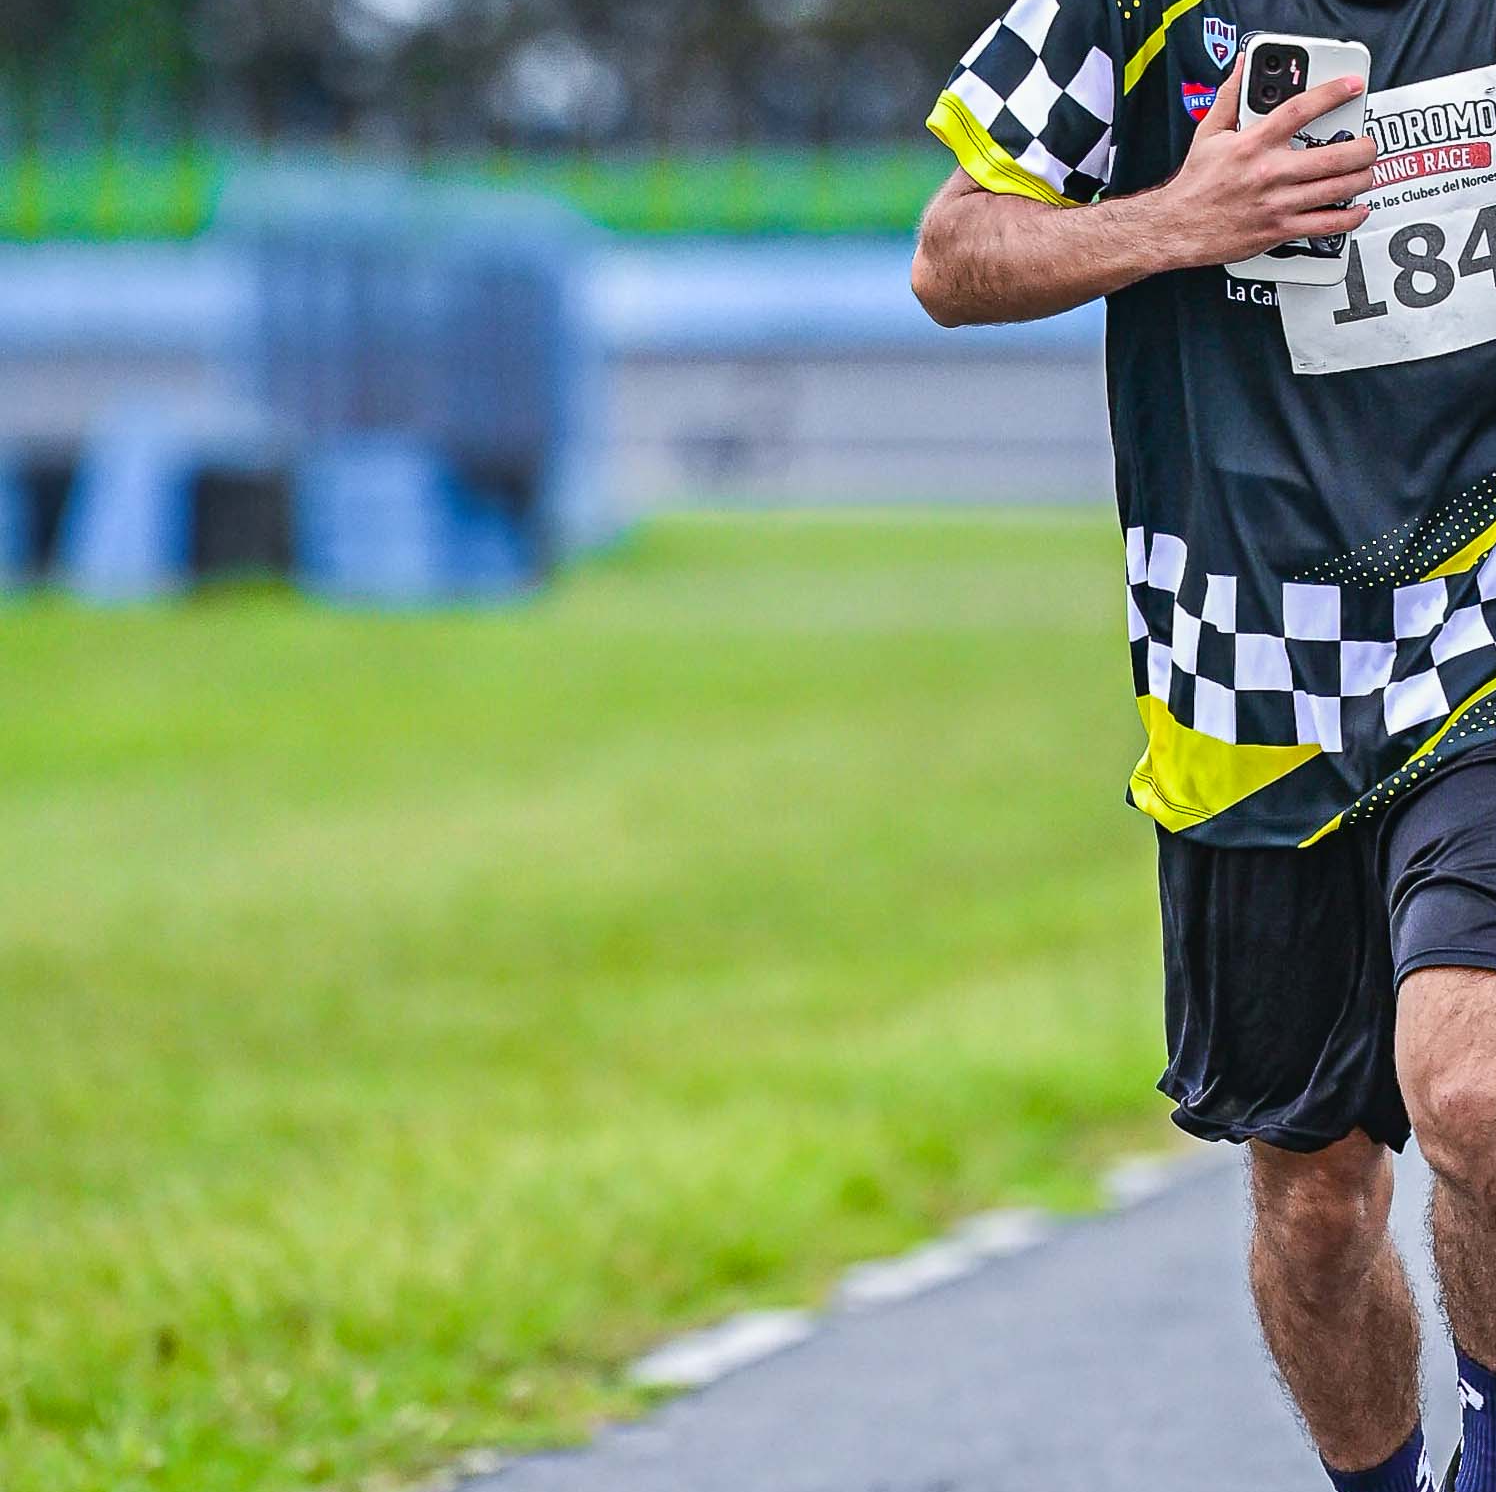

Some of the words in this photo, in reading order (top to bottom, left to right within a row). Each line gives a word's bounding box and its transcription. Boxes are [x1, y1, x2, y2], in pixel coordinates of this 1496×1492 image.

[1370, 155, 1418, 186] NING
[1422, 147, 1472, 173] RACE
[1383, 196, 1400, 208] los
[1401, 187, 1440, 203] Clubes
[1442, 180, 1460, 194] del
[1226, 279, 1246, 302] La
